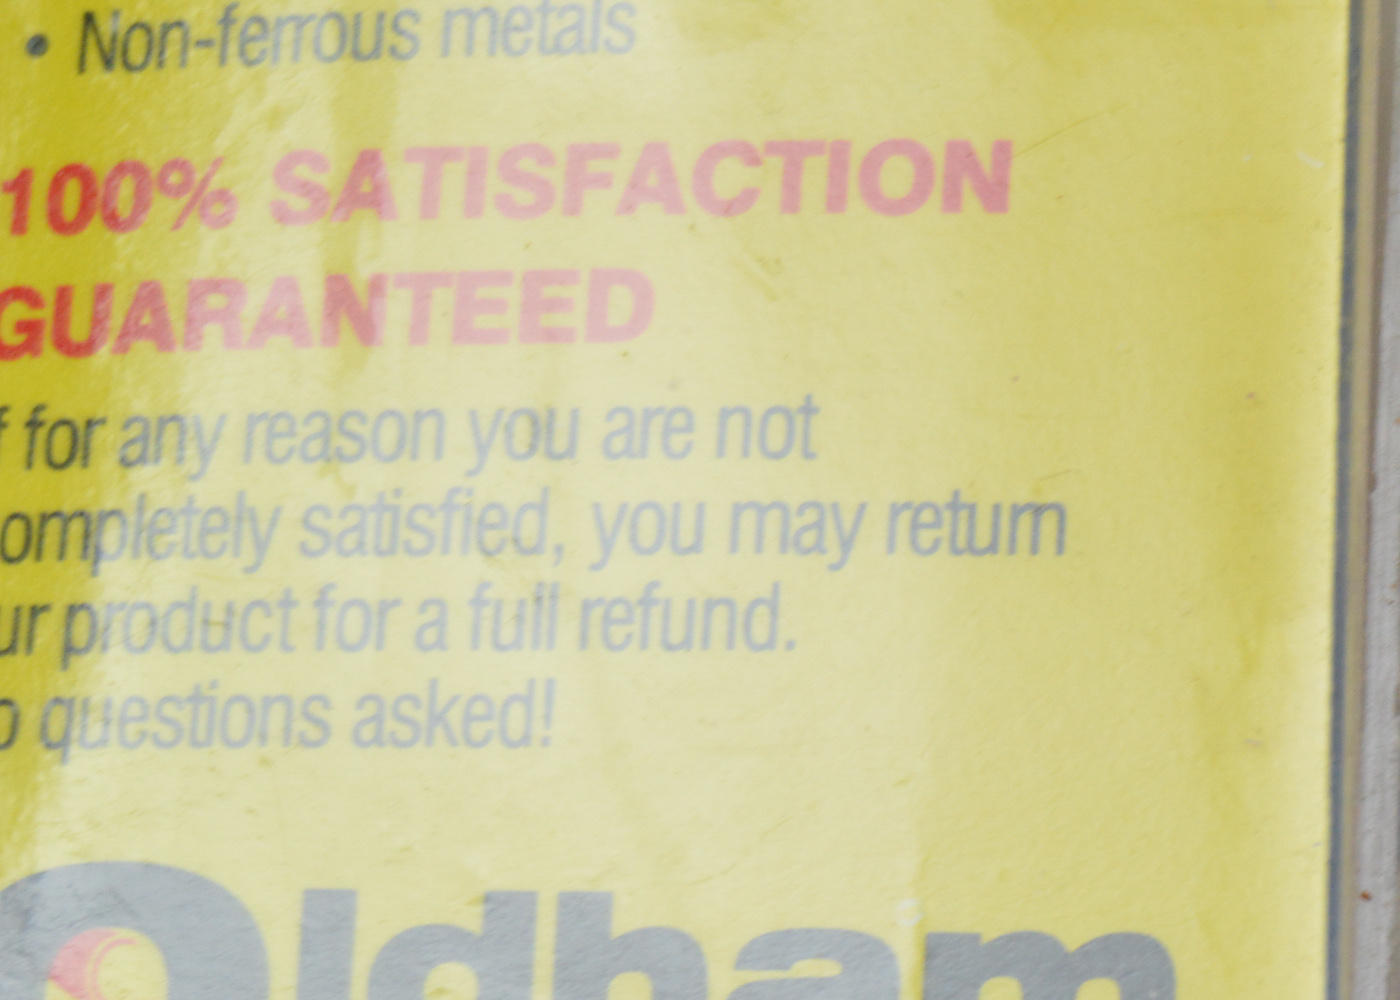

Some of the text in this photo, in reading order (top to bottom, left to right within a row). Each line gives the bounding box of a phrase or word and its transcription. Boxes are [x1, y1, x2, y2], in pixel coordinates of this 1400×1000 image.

[78, 0, 637, 74] Non-ferrous metals
[0, 139, 1013, 236] 100% SATISFACTION
[0, 268, 654, 361] GUARANTEED
[24, 403, 107, 471] for
[117, 411, 226, 481] any
[243, 407, 446, 464] reason
[466, 405, 578, 476] you
[601, 404, 695, 460] are
[715, 394, 820, 460] not
[299, 486, 563, 568] satisfied,
[589, 500, 704, 571] you
[728, 500, 868, 571] may
[885, 489, 1067, 557] return
[62, 586, 298, 671] product
[313, 583, 402, 652] for
[414, 598, 449, 652] a
[469, 581, 559, 652] full
[578, 580, 796, 652] refund.
[40, 680, 332, 765] questions
[351, 678, 557, 748] asked!
